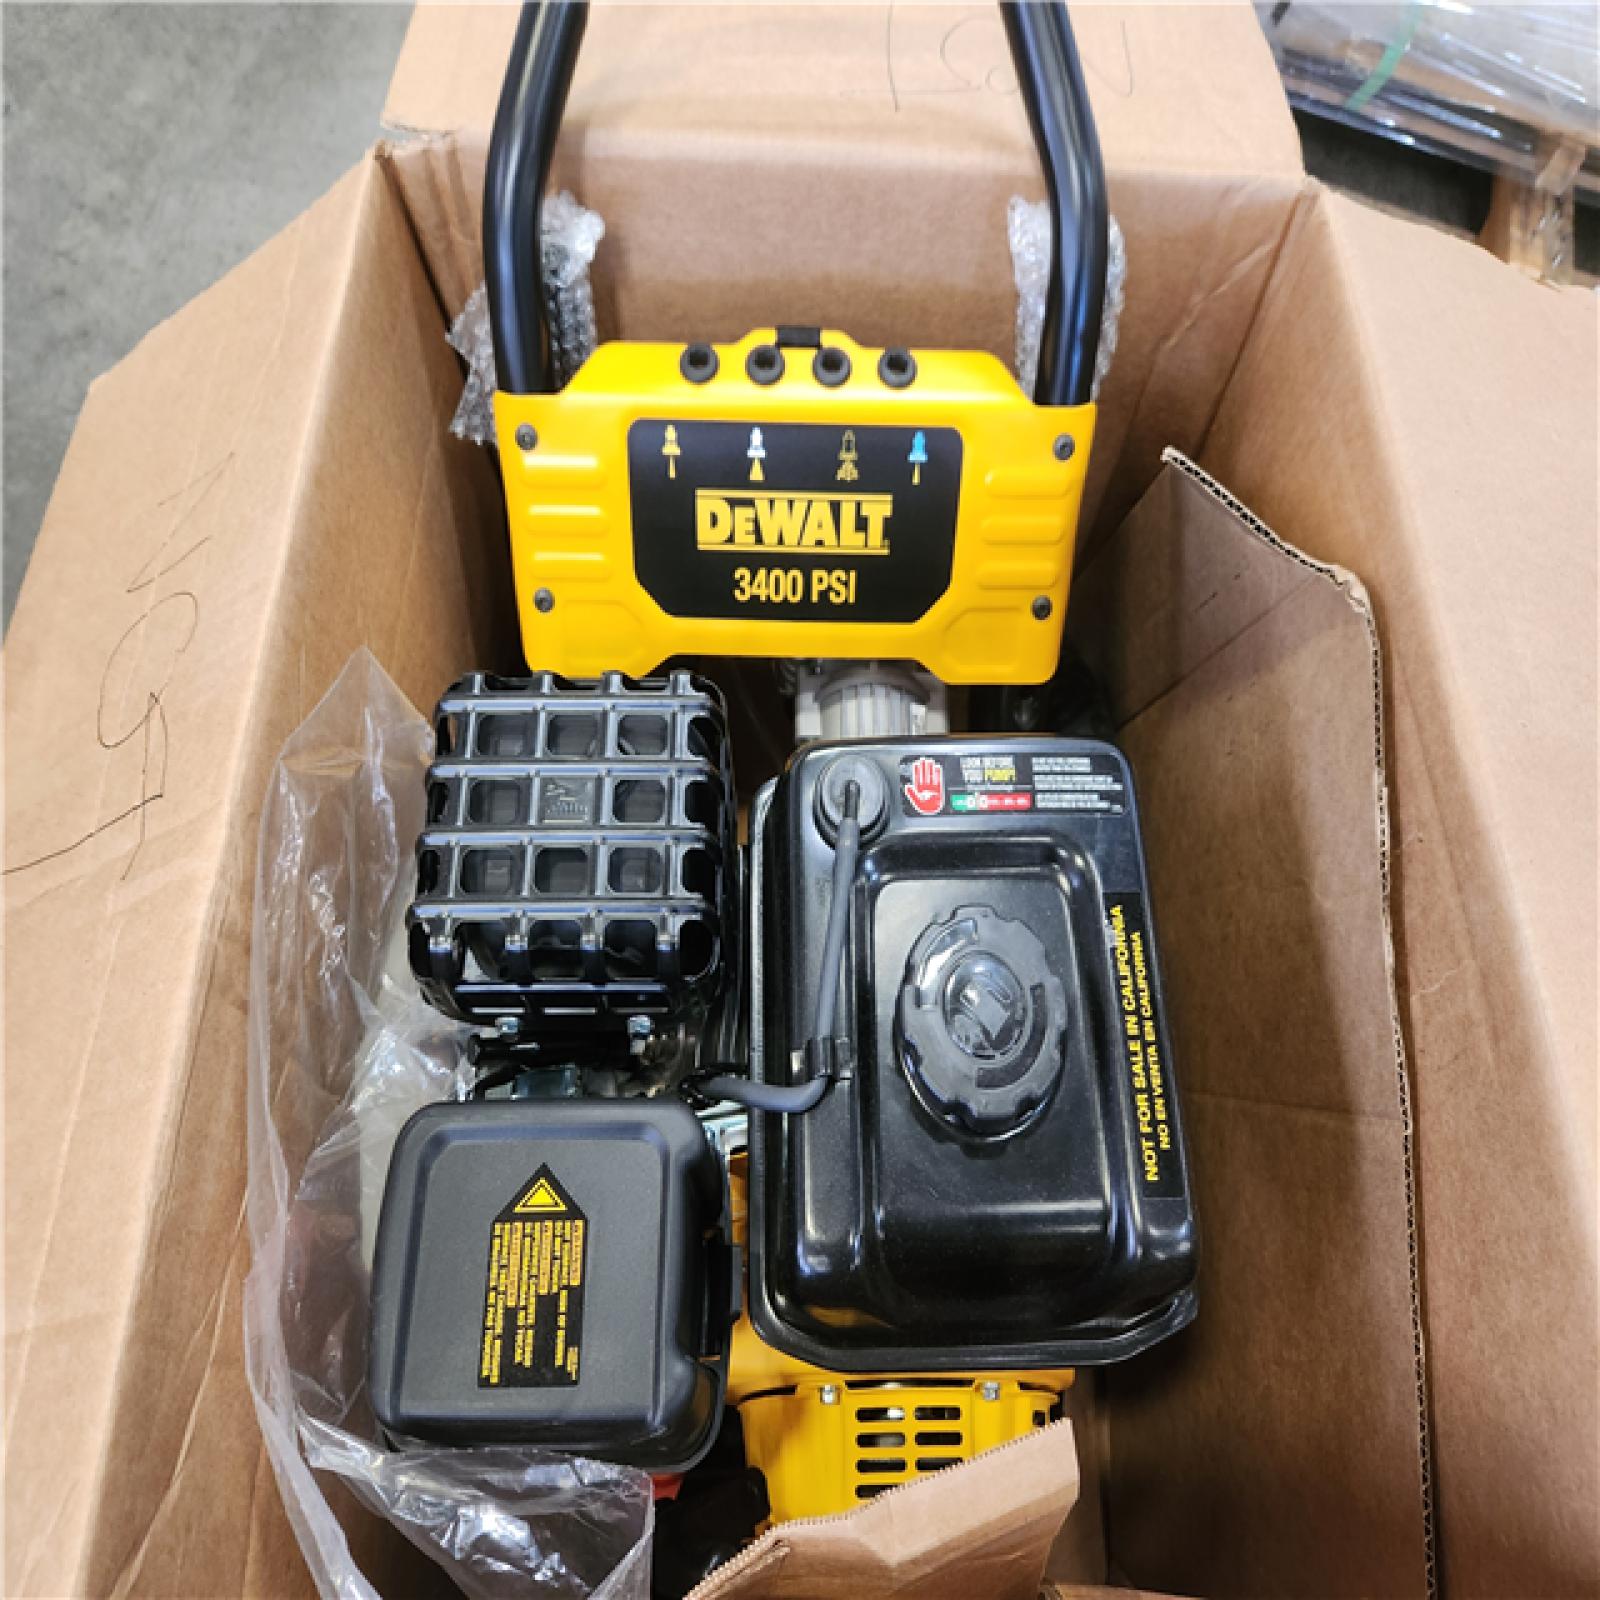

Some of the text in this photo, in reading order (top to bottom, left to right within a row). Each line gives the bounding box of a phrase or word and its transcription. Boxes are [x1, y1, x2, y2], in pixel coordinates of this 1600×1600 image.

[733, 566, 858, 604] 3400 PSI
[1109, 904, 1160, 1182] NOT FOR SALE IN CALIFORNIA
[1129, 931, 1171, 1150] NO EN VENTA EN CALIFORNIA
